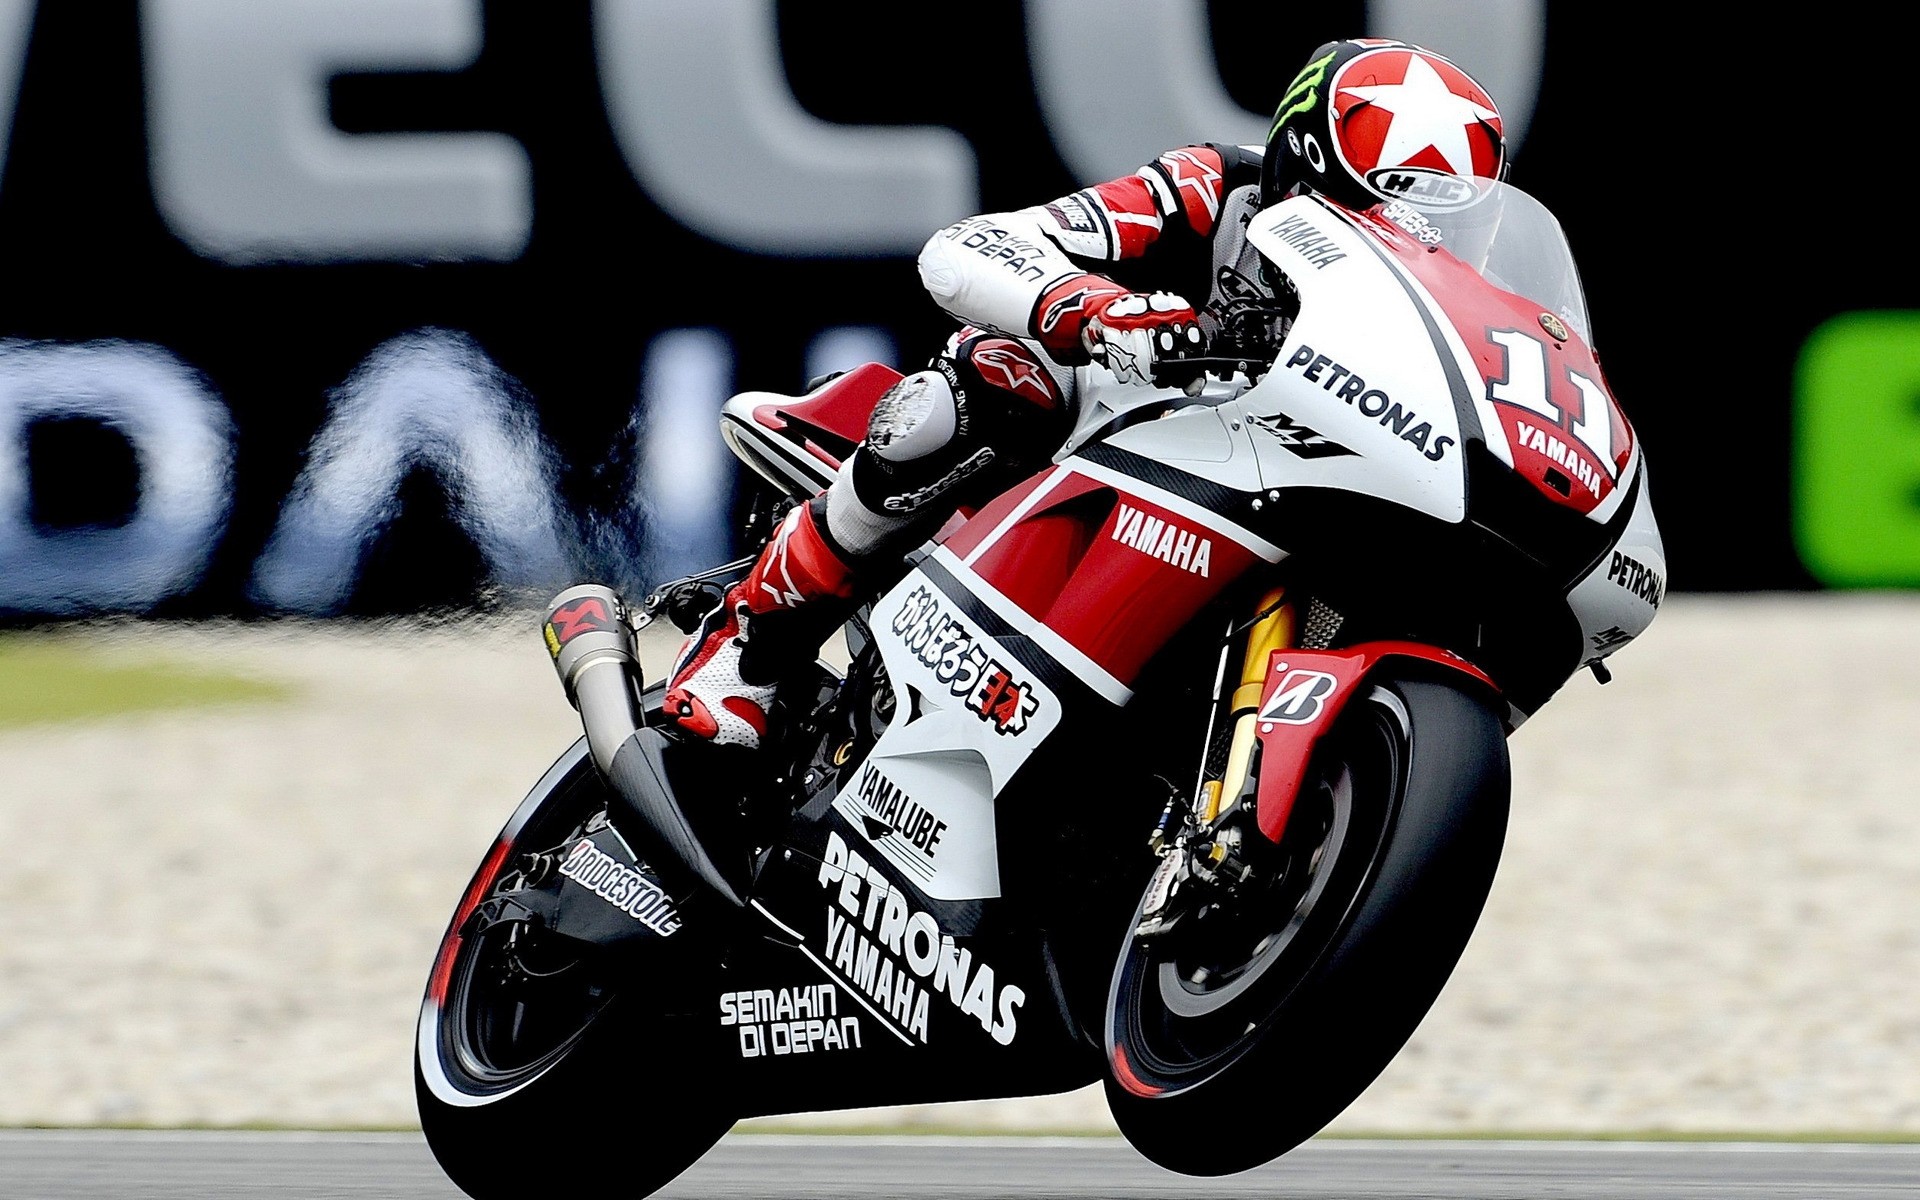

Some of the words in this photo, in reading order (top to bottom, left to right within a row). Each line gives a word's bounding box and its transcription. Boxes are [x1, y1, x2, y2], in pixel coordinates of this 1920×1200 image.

[1381, 200, 1430, 235] SPIES
[1382, 173, 1467, 200] HJC
[962, 232, 1045, 283] DEPAN
[1268, 213, 1348, 271] YAMAHA
[1285, 344, 1455, 462] PETRONAS
[1485, 323, 1619, 489] 11
[1515, 421, 1601, 500] YAMAHA
[1111, 503, 1212, 579] YAMAHA
[857, 760, 948, 859] YAMALUBE
[818, 831, 1026, 1046] PETRONAS
[825, 905, 930, 1045] YAMAHA
[720, 984, 837, 1026] SEMAKIN
[739, 1024, 767, 1058] DI
[771, 1017, 862, 1056] DEPAN
